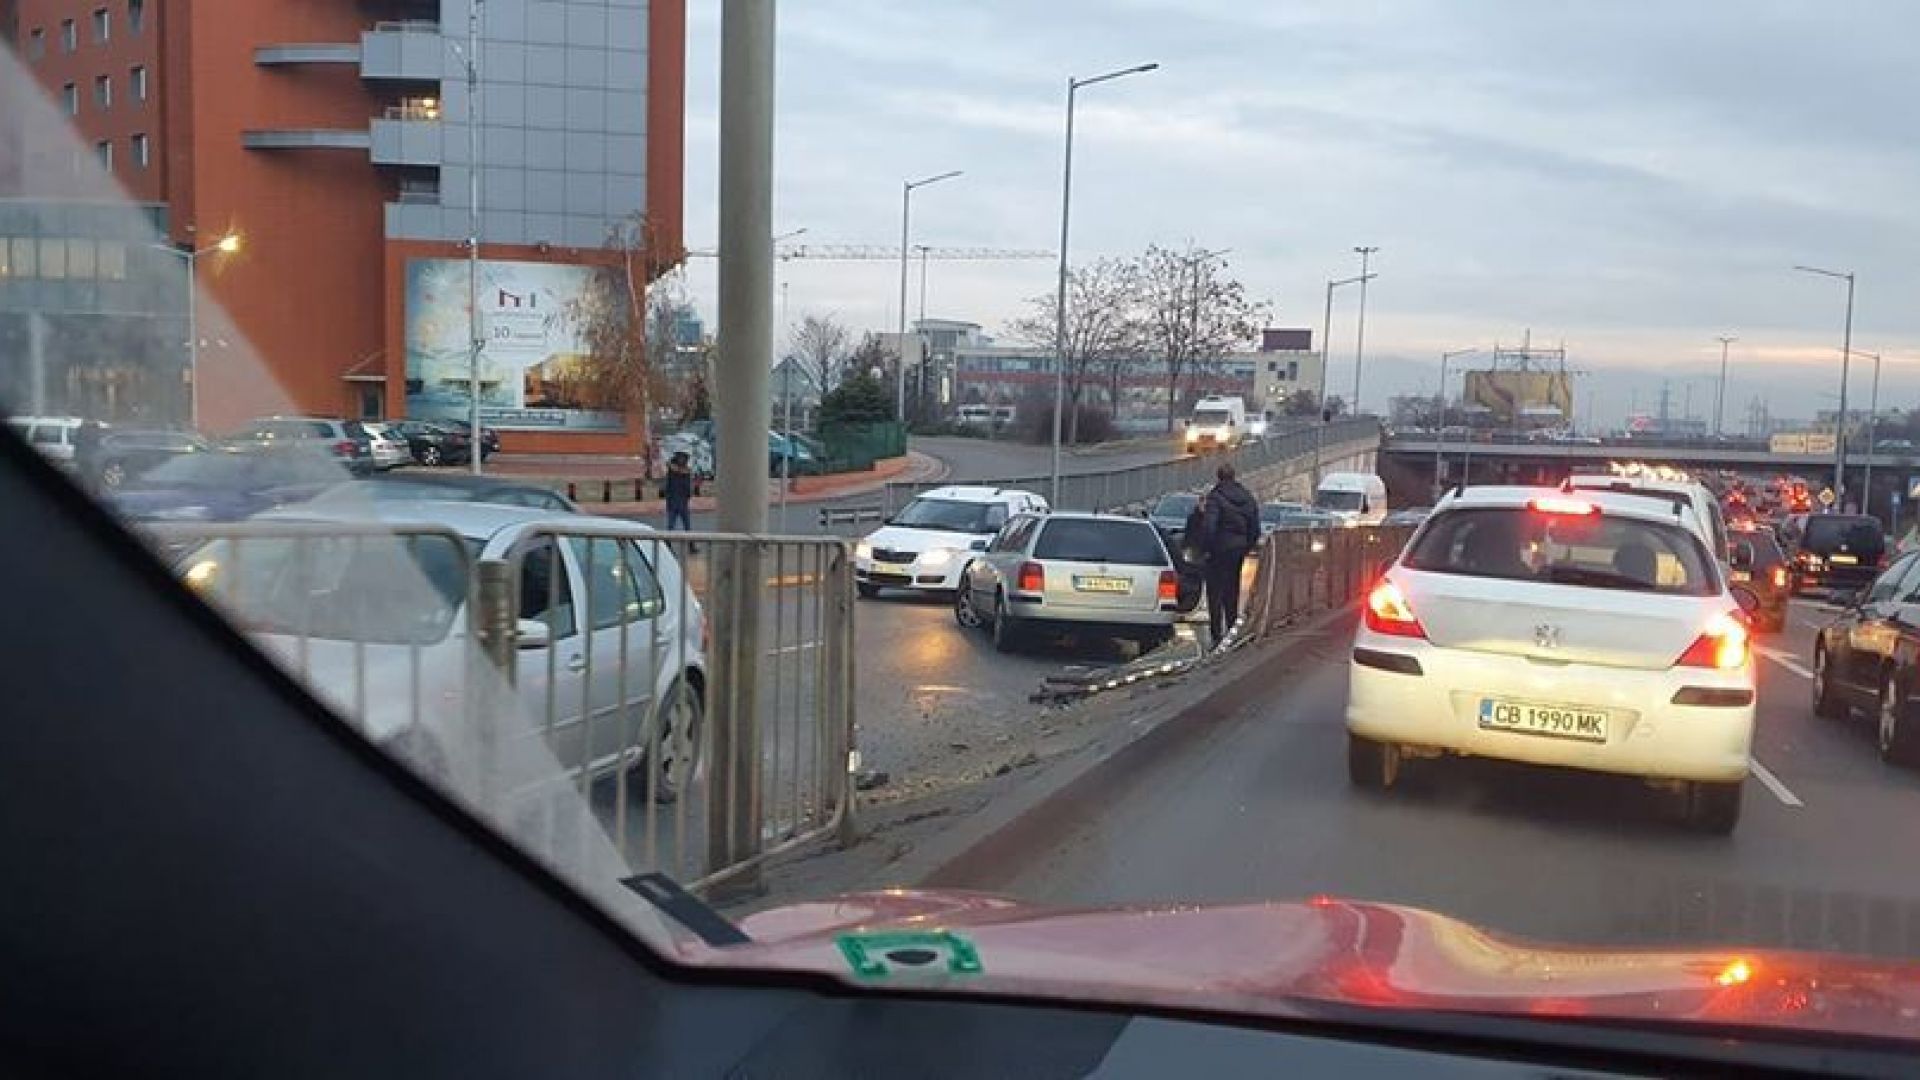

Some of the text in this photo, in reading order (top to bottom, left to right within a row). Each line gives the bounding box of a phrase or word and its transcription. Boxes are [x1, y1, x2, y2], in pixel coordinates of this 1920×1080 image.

[1496, 705, 1602, 734] CB 1990 MK
